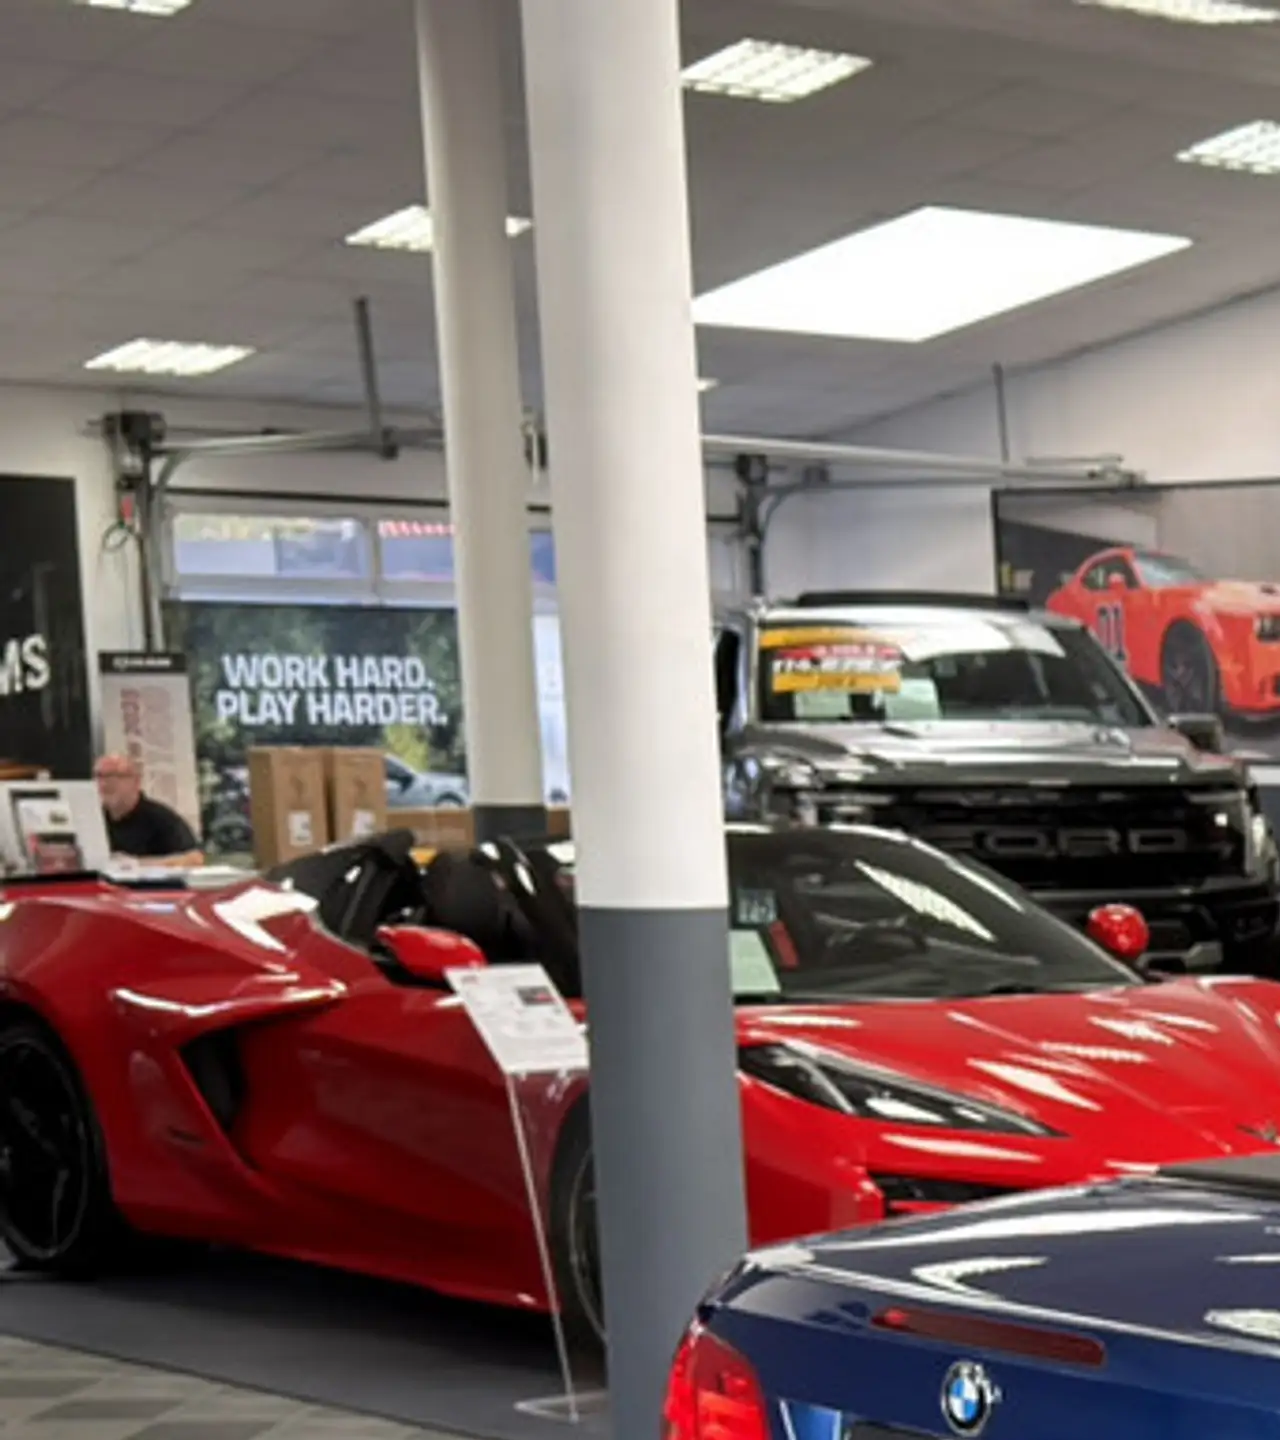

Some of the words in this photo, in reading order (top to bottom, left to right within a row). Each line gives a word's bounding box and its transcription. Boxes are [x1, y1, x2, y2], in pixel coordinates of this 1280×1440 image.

[221, 653, 331, 689] WORK
[334, 654, 437, 690] HARD.
[216, 690, 299, 726] PLAY
[305, 691, 449, 726] HARDER.
